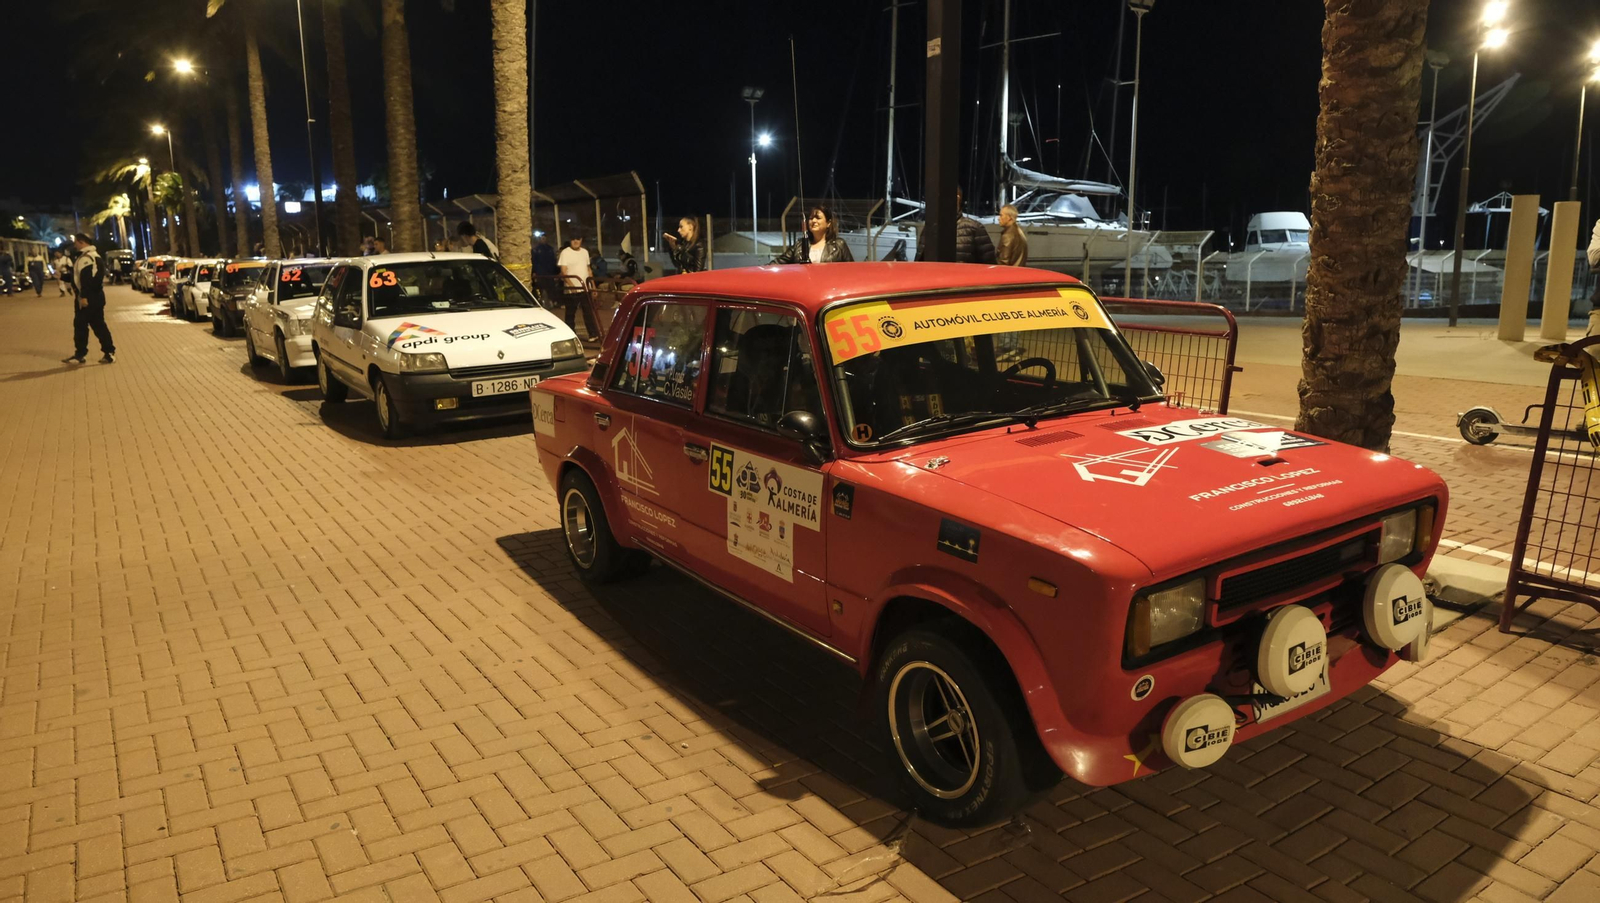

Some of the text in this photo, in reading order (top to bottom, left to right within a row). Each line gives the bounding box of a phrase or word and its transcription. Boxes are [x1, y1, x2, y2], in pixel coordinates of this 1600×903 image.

[281, 269, 302, 282] 62
[369, 270, 397, 288] 63
[913, 306, 1069, 330] AUTOMÓVIL CLUB DE ALMERÍA
[402, 333, 490, 349] apdi group
[826, 314, 882, 359] 55
[663, 381, 693, 401] C.Vasile
[856, 426, 868, 440] H
[711, 449, 733, 494] 55
[1188, 467, 1321, 502] FRANCISCO LOPEZ
[783, 485, 808, 502] COSTA
[807, 493, 817, 505] DE
[620, 494, 677, 528] FRANCISCO LOPEZ
[774, 499, 817, 523] ALMERÍA
[1398, 601, 1422, 615] CIBIE
[1409, 610, 1422, 619] IODE
[1294, 647, 1322, 663] CIBIE
[1306, 655, 1322, 667] IODE
[1194, 729, 1228, 743] CIBIE
[1207, 737, 1228, 747] IODE
